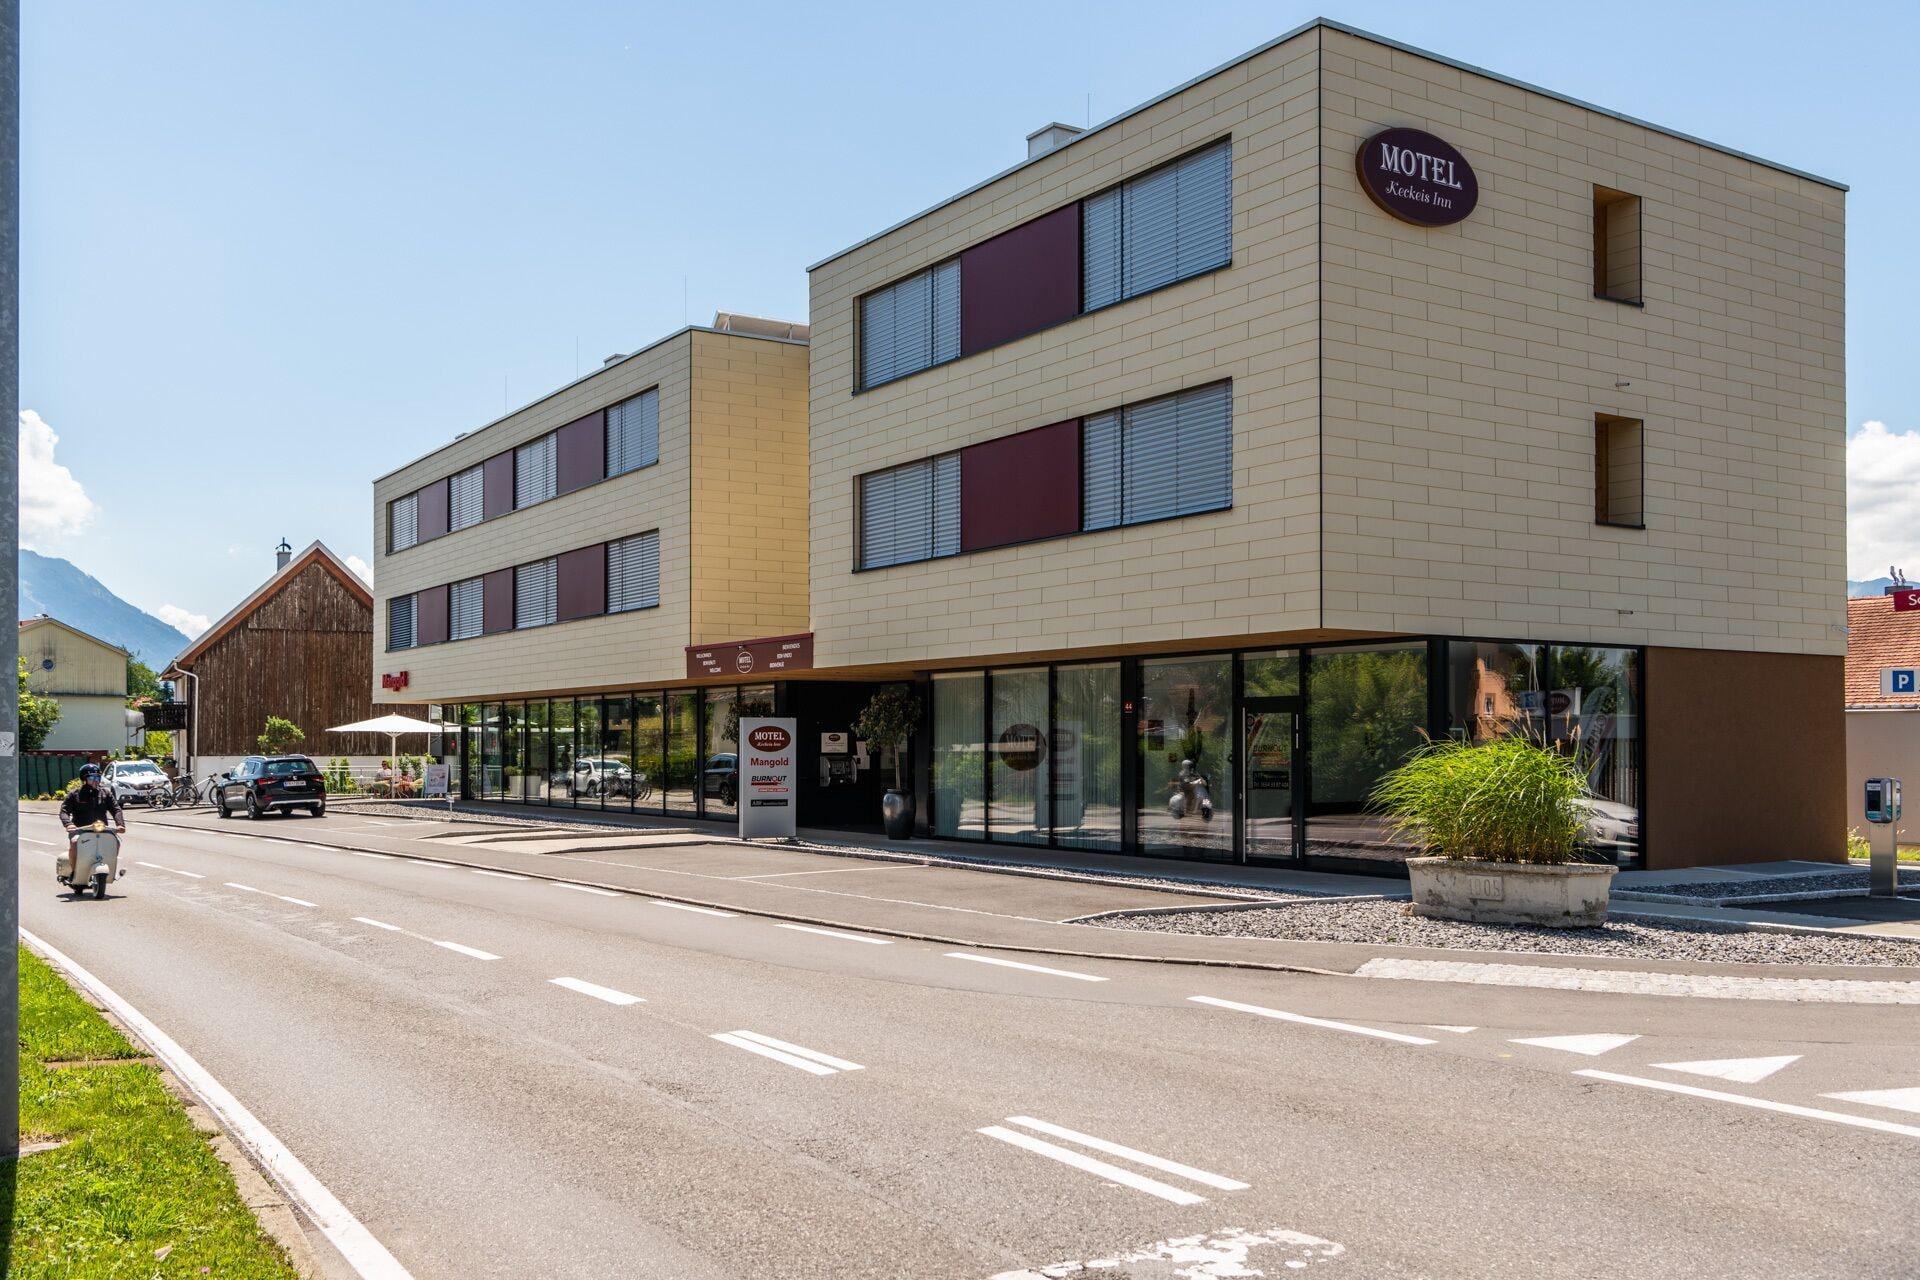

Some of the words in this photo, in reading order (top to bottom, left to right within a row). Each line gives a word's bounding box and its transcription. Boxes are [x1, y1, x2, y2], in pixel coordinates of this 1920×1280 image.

[1380, 142, 1462, 190] MOTEL
[1385, 180, 1430, 204] Keckeis
[1432, 191, 1452, 209] Inn
[738, 656, 751, 664] MOTEL
[1898, 674, 1909, 689] P
[754, 731, 784, 741] MOTEL
[750, 757, 789, 768] Mangold
